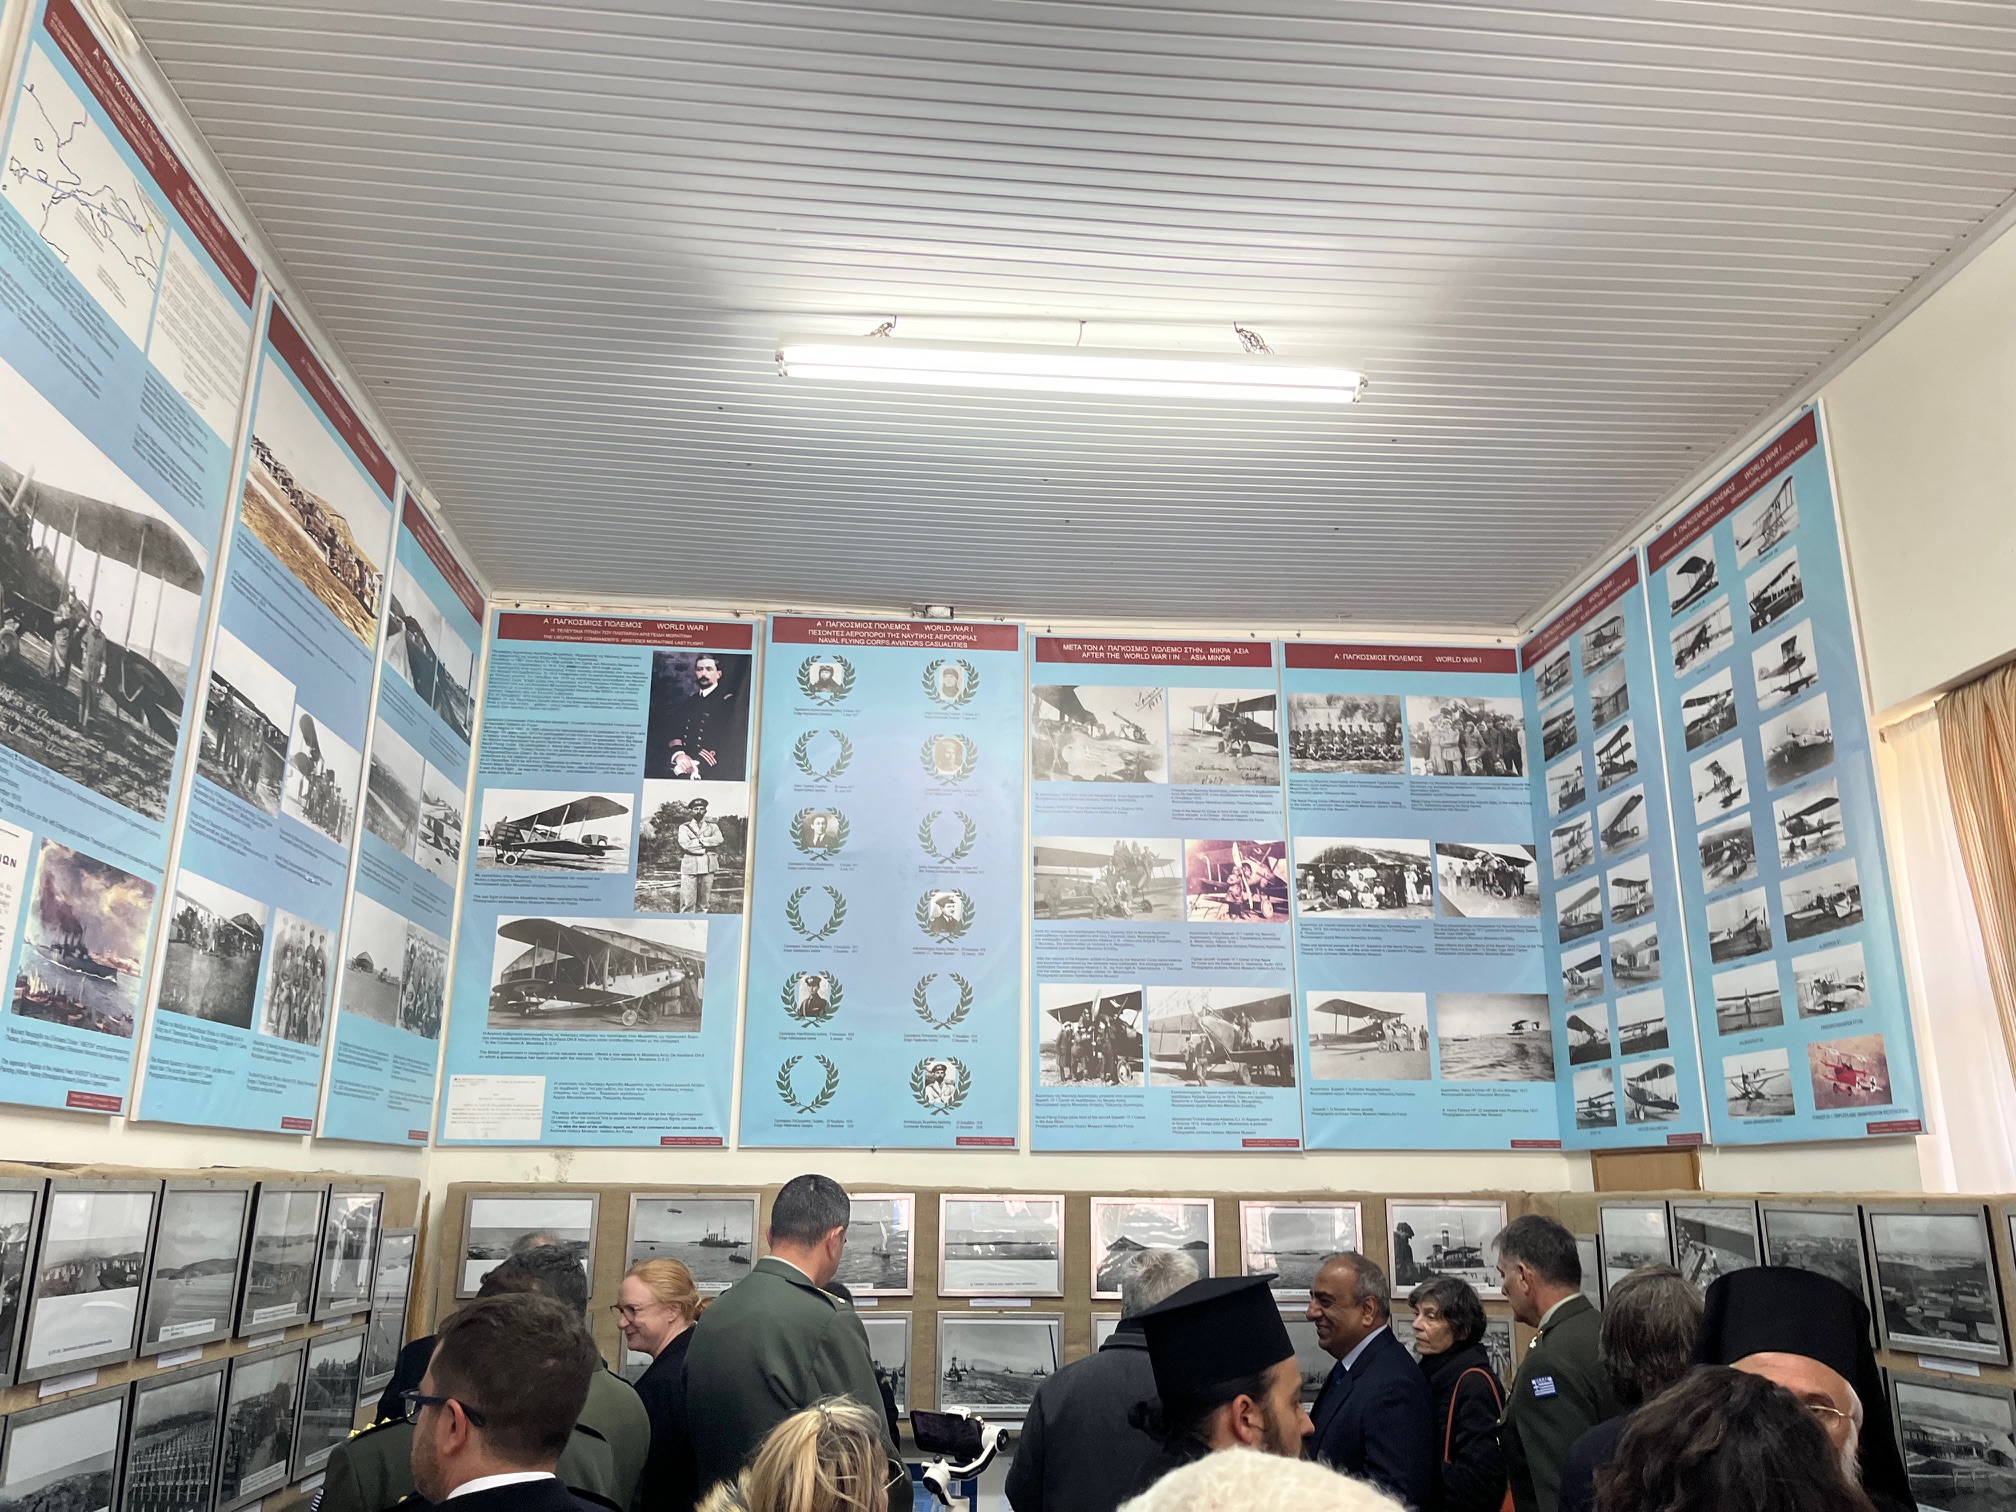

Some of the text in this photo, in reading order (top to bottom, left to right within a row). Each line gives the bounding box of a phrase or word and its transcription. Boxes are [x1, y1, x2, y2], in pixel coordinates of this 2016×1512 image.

[1744, 459, 1765, 480] WORLD
[1765, 449, 1778, 463] WAR
[553, 617, 602, 625] ΠΑΓΚΟΣΜΙΟΣ
